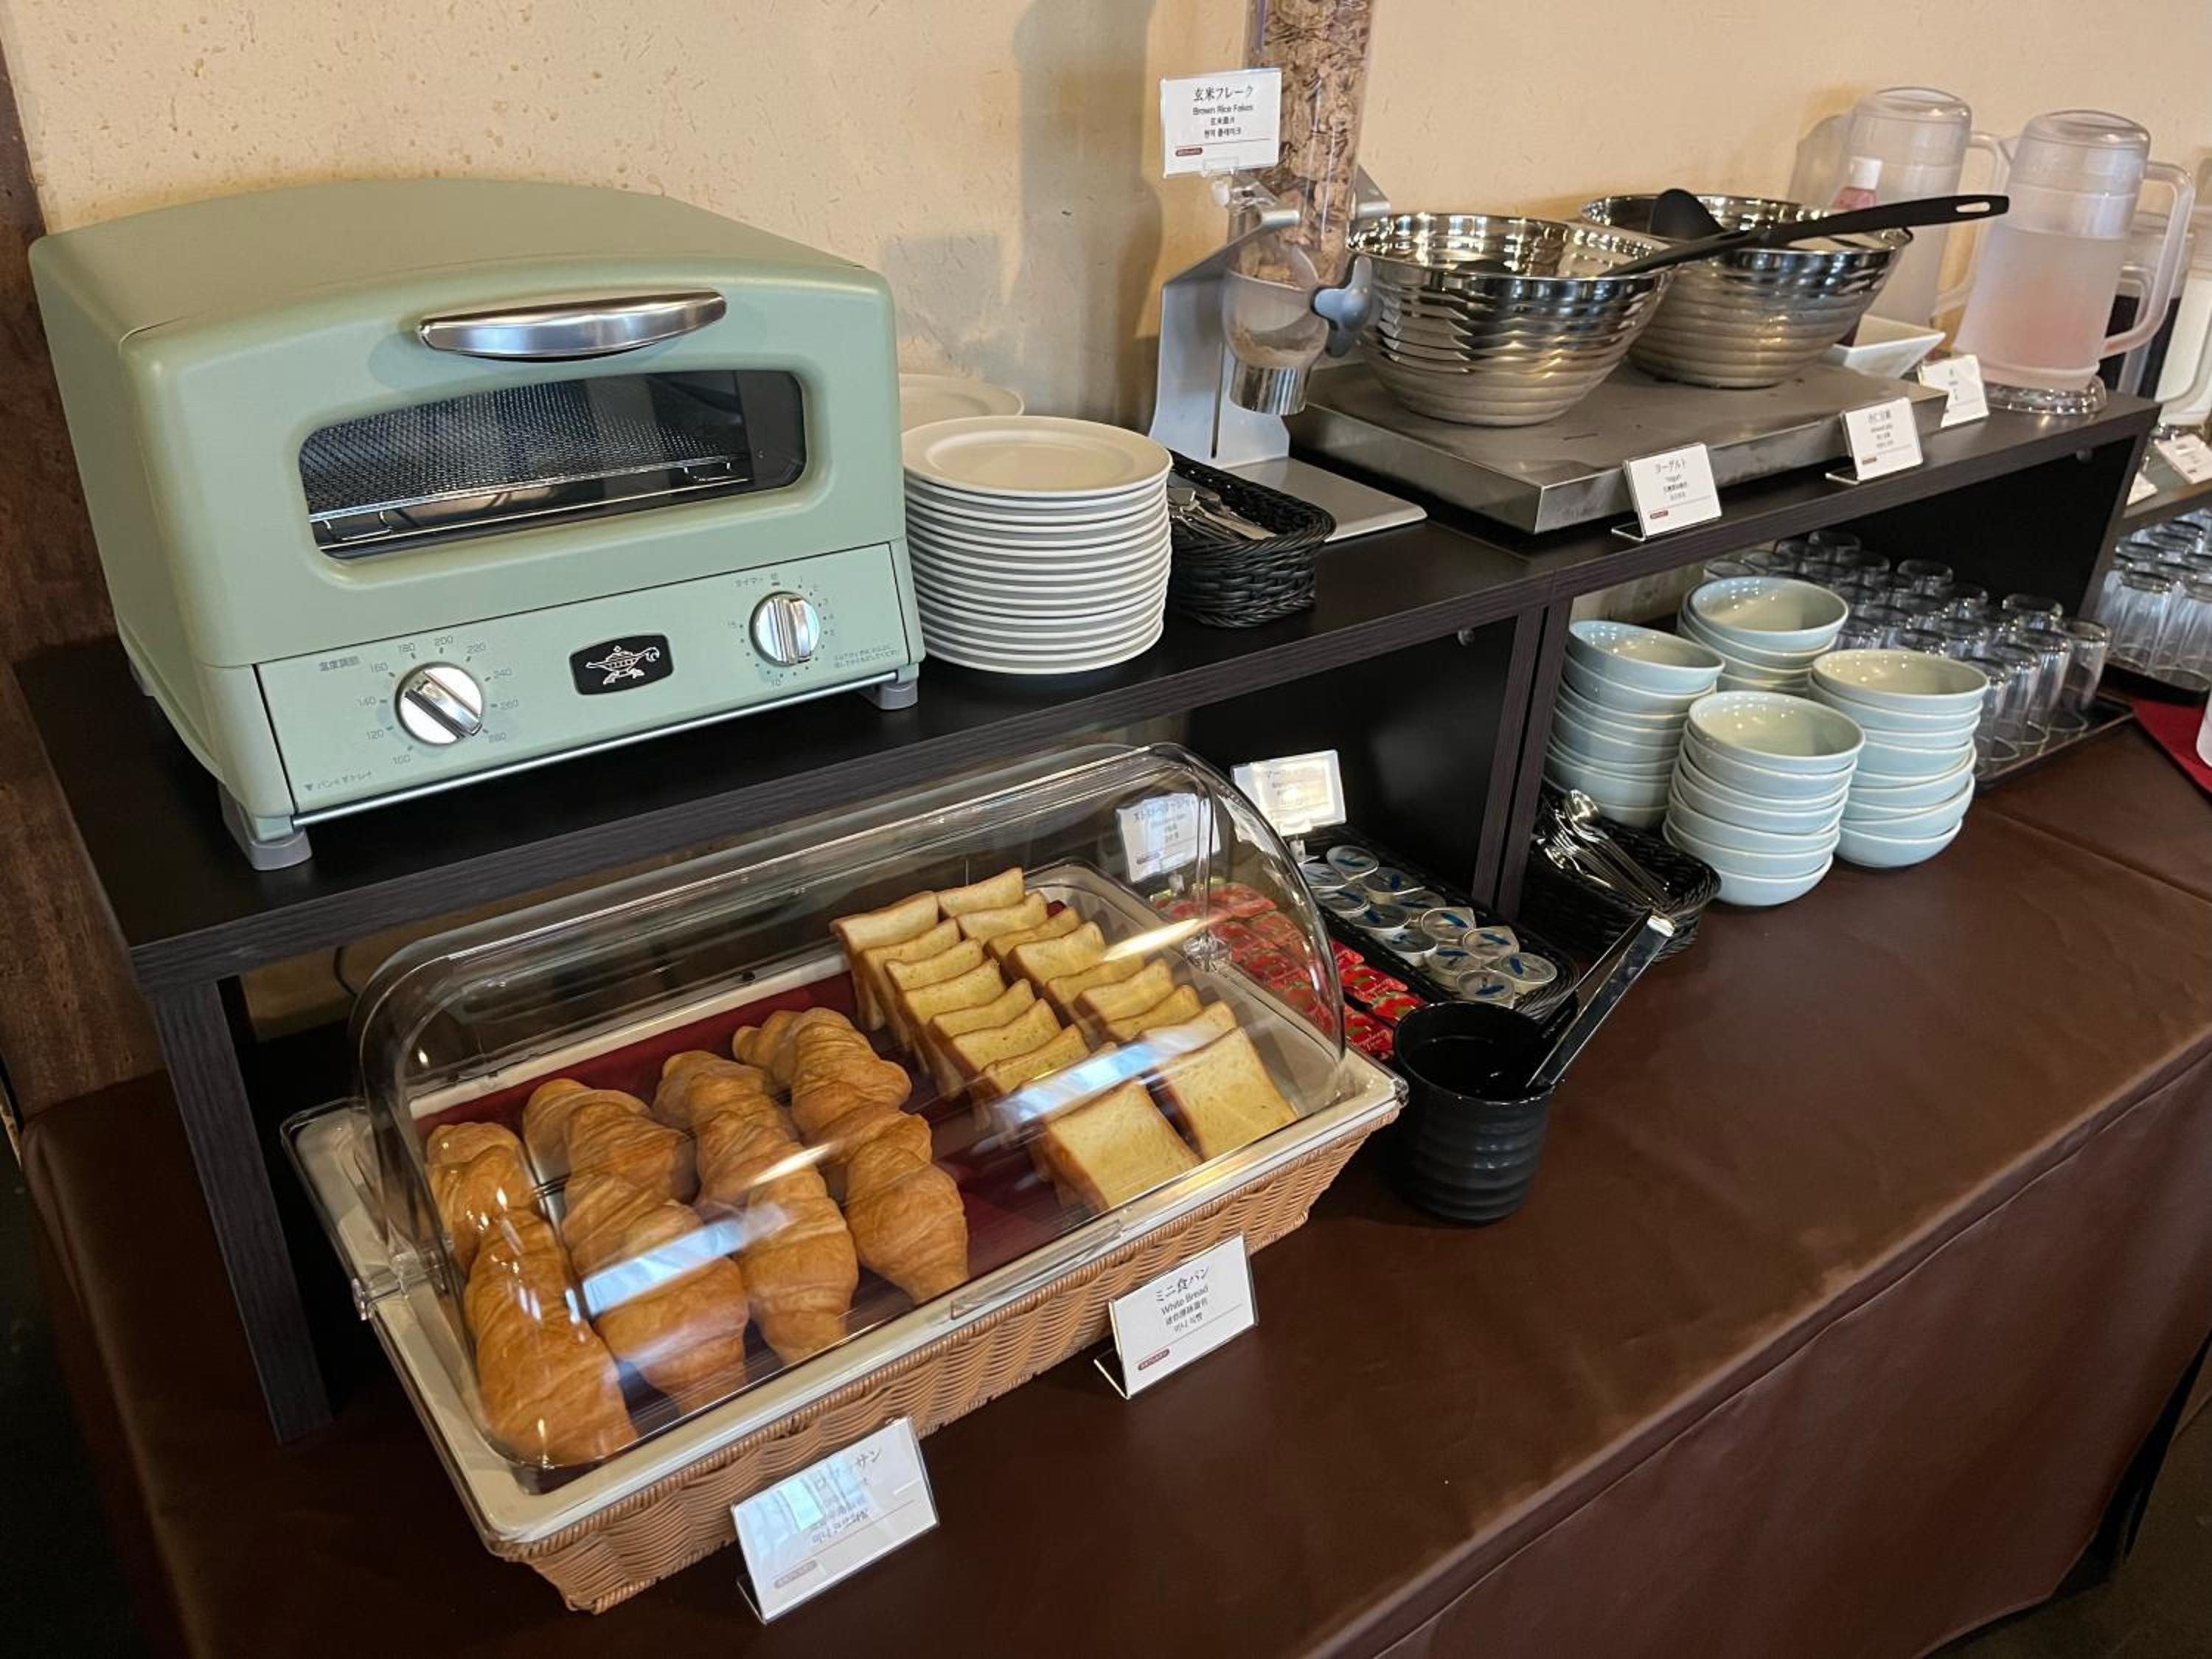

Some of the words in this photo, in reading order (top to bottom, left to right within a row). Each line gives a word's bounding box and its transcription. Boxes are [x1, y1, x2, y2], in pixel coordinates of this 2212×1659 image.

[1193, 86, 1253, 102] 玄米フレーク
[1192, 106, 1216, 116] Brown
[1217, 104, 1232, 113] Rice
[434, 636, 454, 647] 200
[398, 642, 417, 653] 180
[370, 662, 389, 673] 160
[493, 668, 513, 679] 240
[366, 729, 383, 740] 120
[1156, 1267, 1210, 1301] ミニ食パン
[1161, 1298, 1185, 1315] White
[1186, 1284, 1208, 1303] Bread
